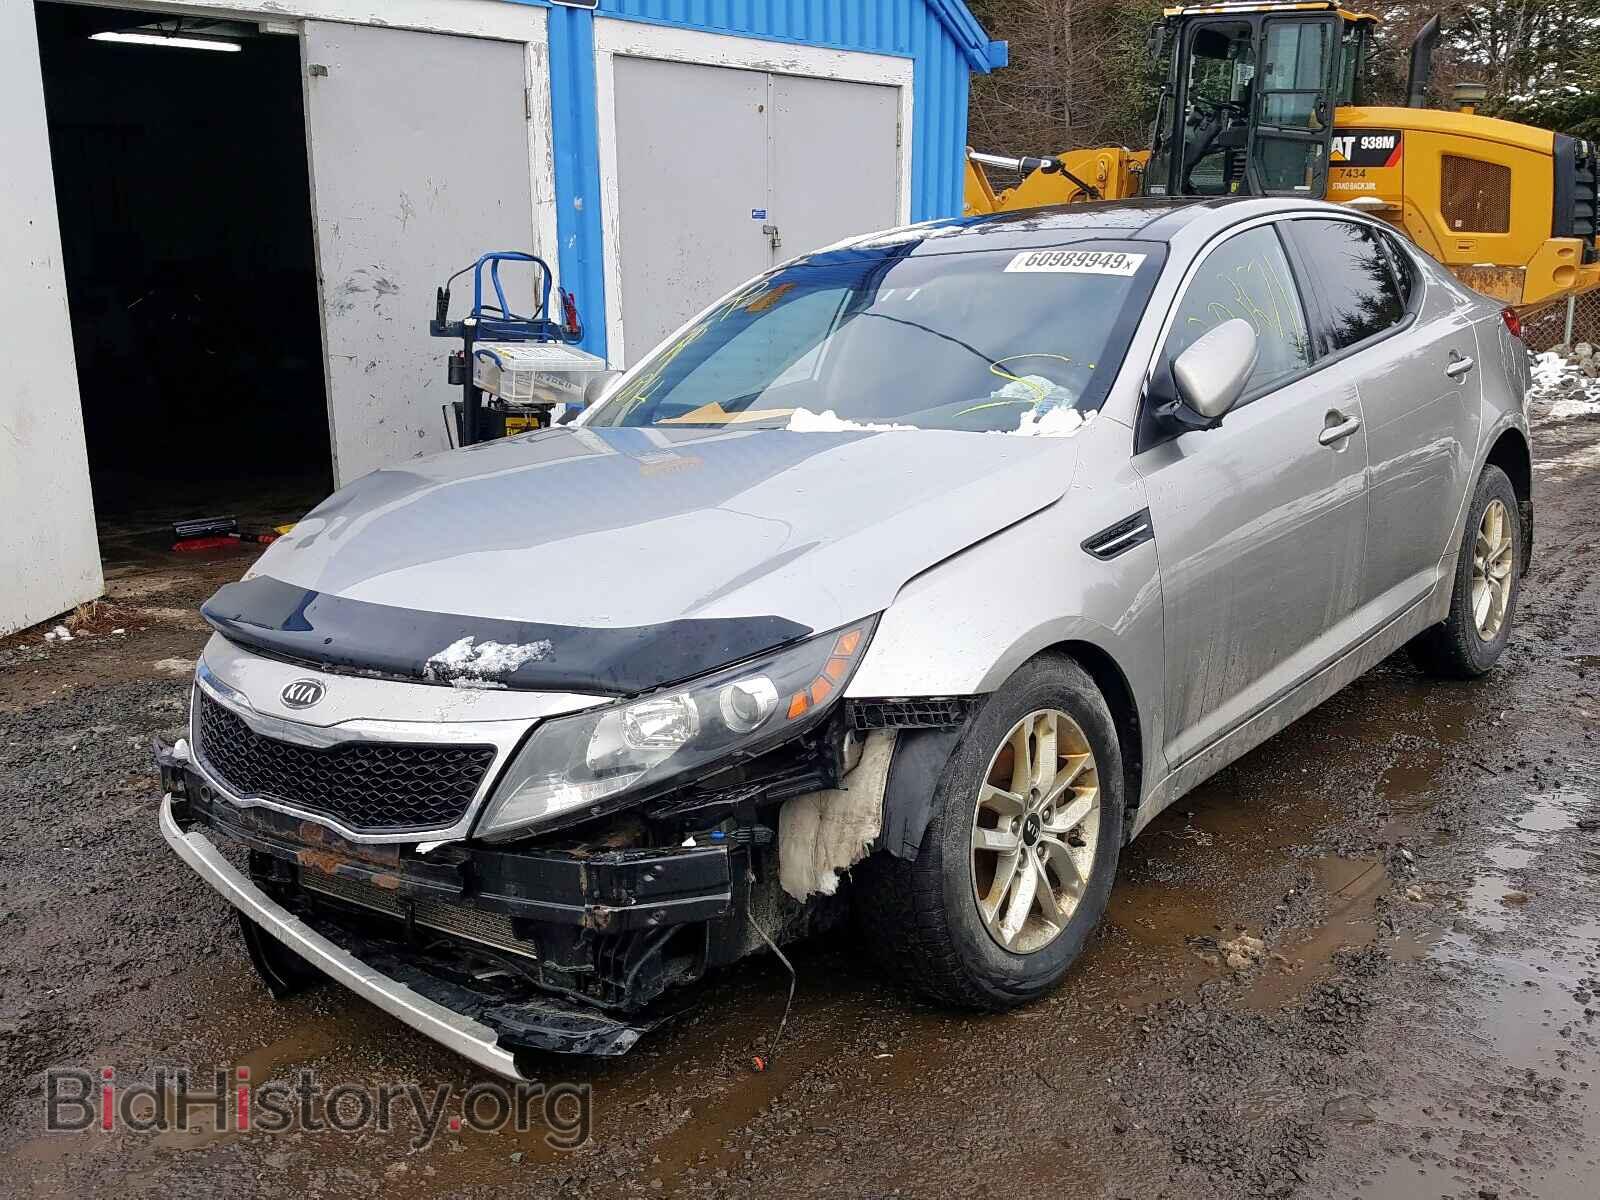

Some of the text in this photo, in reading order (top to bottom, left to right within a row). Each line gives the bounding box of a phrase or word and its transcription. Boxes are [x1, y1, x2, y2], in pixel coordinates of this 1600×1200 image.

[1331, 135, 1395, 161] AT 938M
[1339, 168, 1366, 178] 7434
[285, 683, 316, 703] KIA
